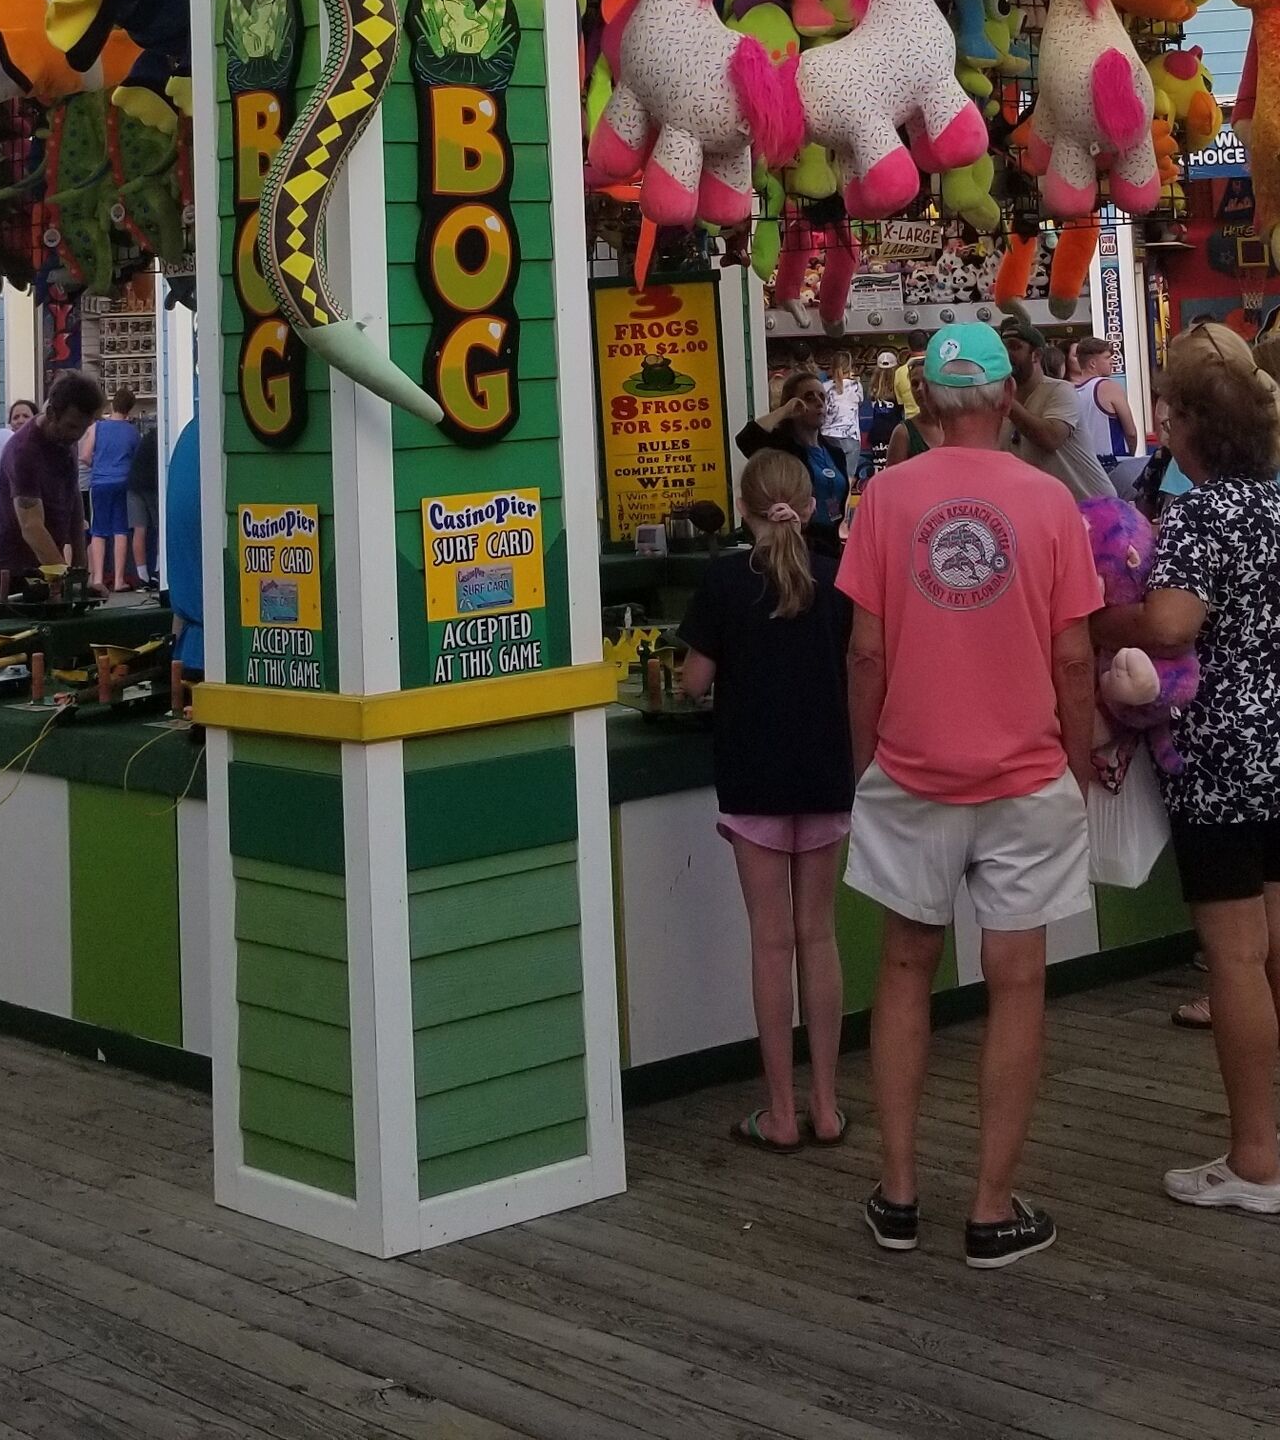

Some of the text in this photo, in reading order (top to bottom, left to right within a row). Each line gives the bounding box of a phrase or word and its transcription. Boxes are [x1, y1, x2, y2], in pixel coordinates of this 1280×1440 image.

[884, 224, 939, 244] X-LARGE
[431, 86, 511, 432] BOG
[628, 284, 683, 320] 3
[614, 320, 700, 341] FROGS
[607, 339, 708, 358] FOR $2.00
[610, 395, 710, 420] 8 FROGS
[611, 417, 712, 436] FOR $5.00
[637, 439, 690, 453] RULES
[615, 462, 716, 477] COMPLETELY IN
[637, 453, 692, 464] One Frog
[637, 476, 696, 489] Wins
[626, 493, 648, 501] Win
[628, 503, 656, 511] Wins
[918, 505, 1010, 550] DOLPHIN RESEARCH CENTER
[433, 529, 534, 566] SURF CARD
[246, 546, 312, 574] SURF CARD
[463, 579, 509, 596] SURF CARD
[918, 568, 945, 600] GRASSY
[971, 574, 1006, 603] FLORIDA
[252, 627, 313, 656] ACCEPTED
[443, 613, 532, 650] ACCEPTED
[247, 658, 320, 689] AT THIS GAME
[434, 642, 542, 685] AT THIS GAME
